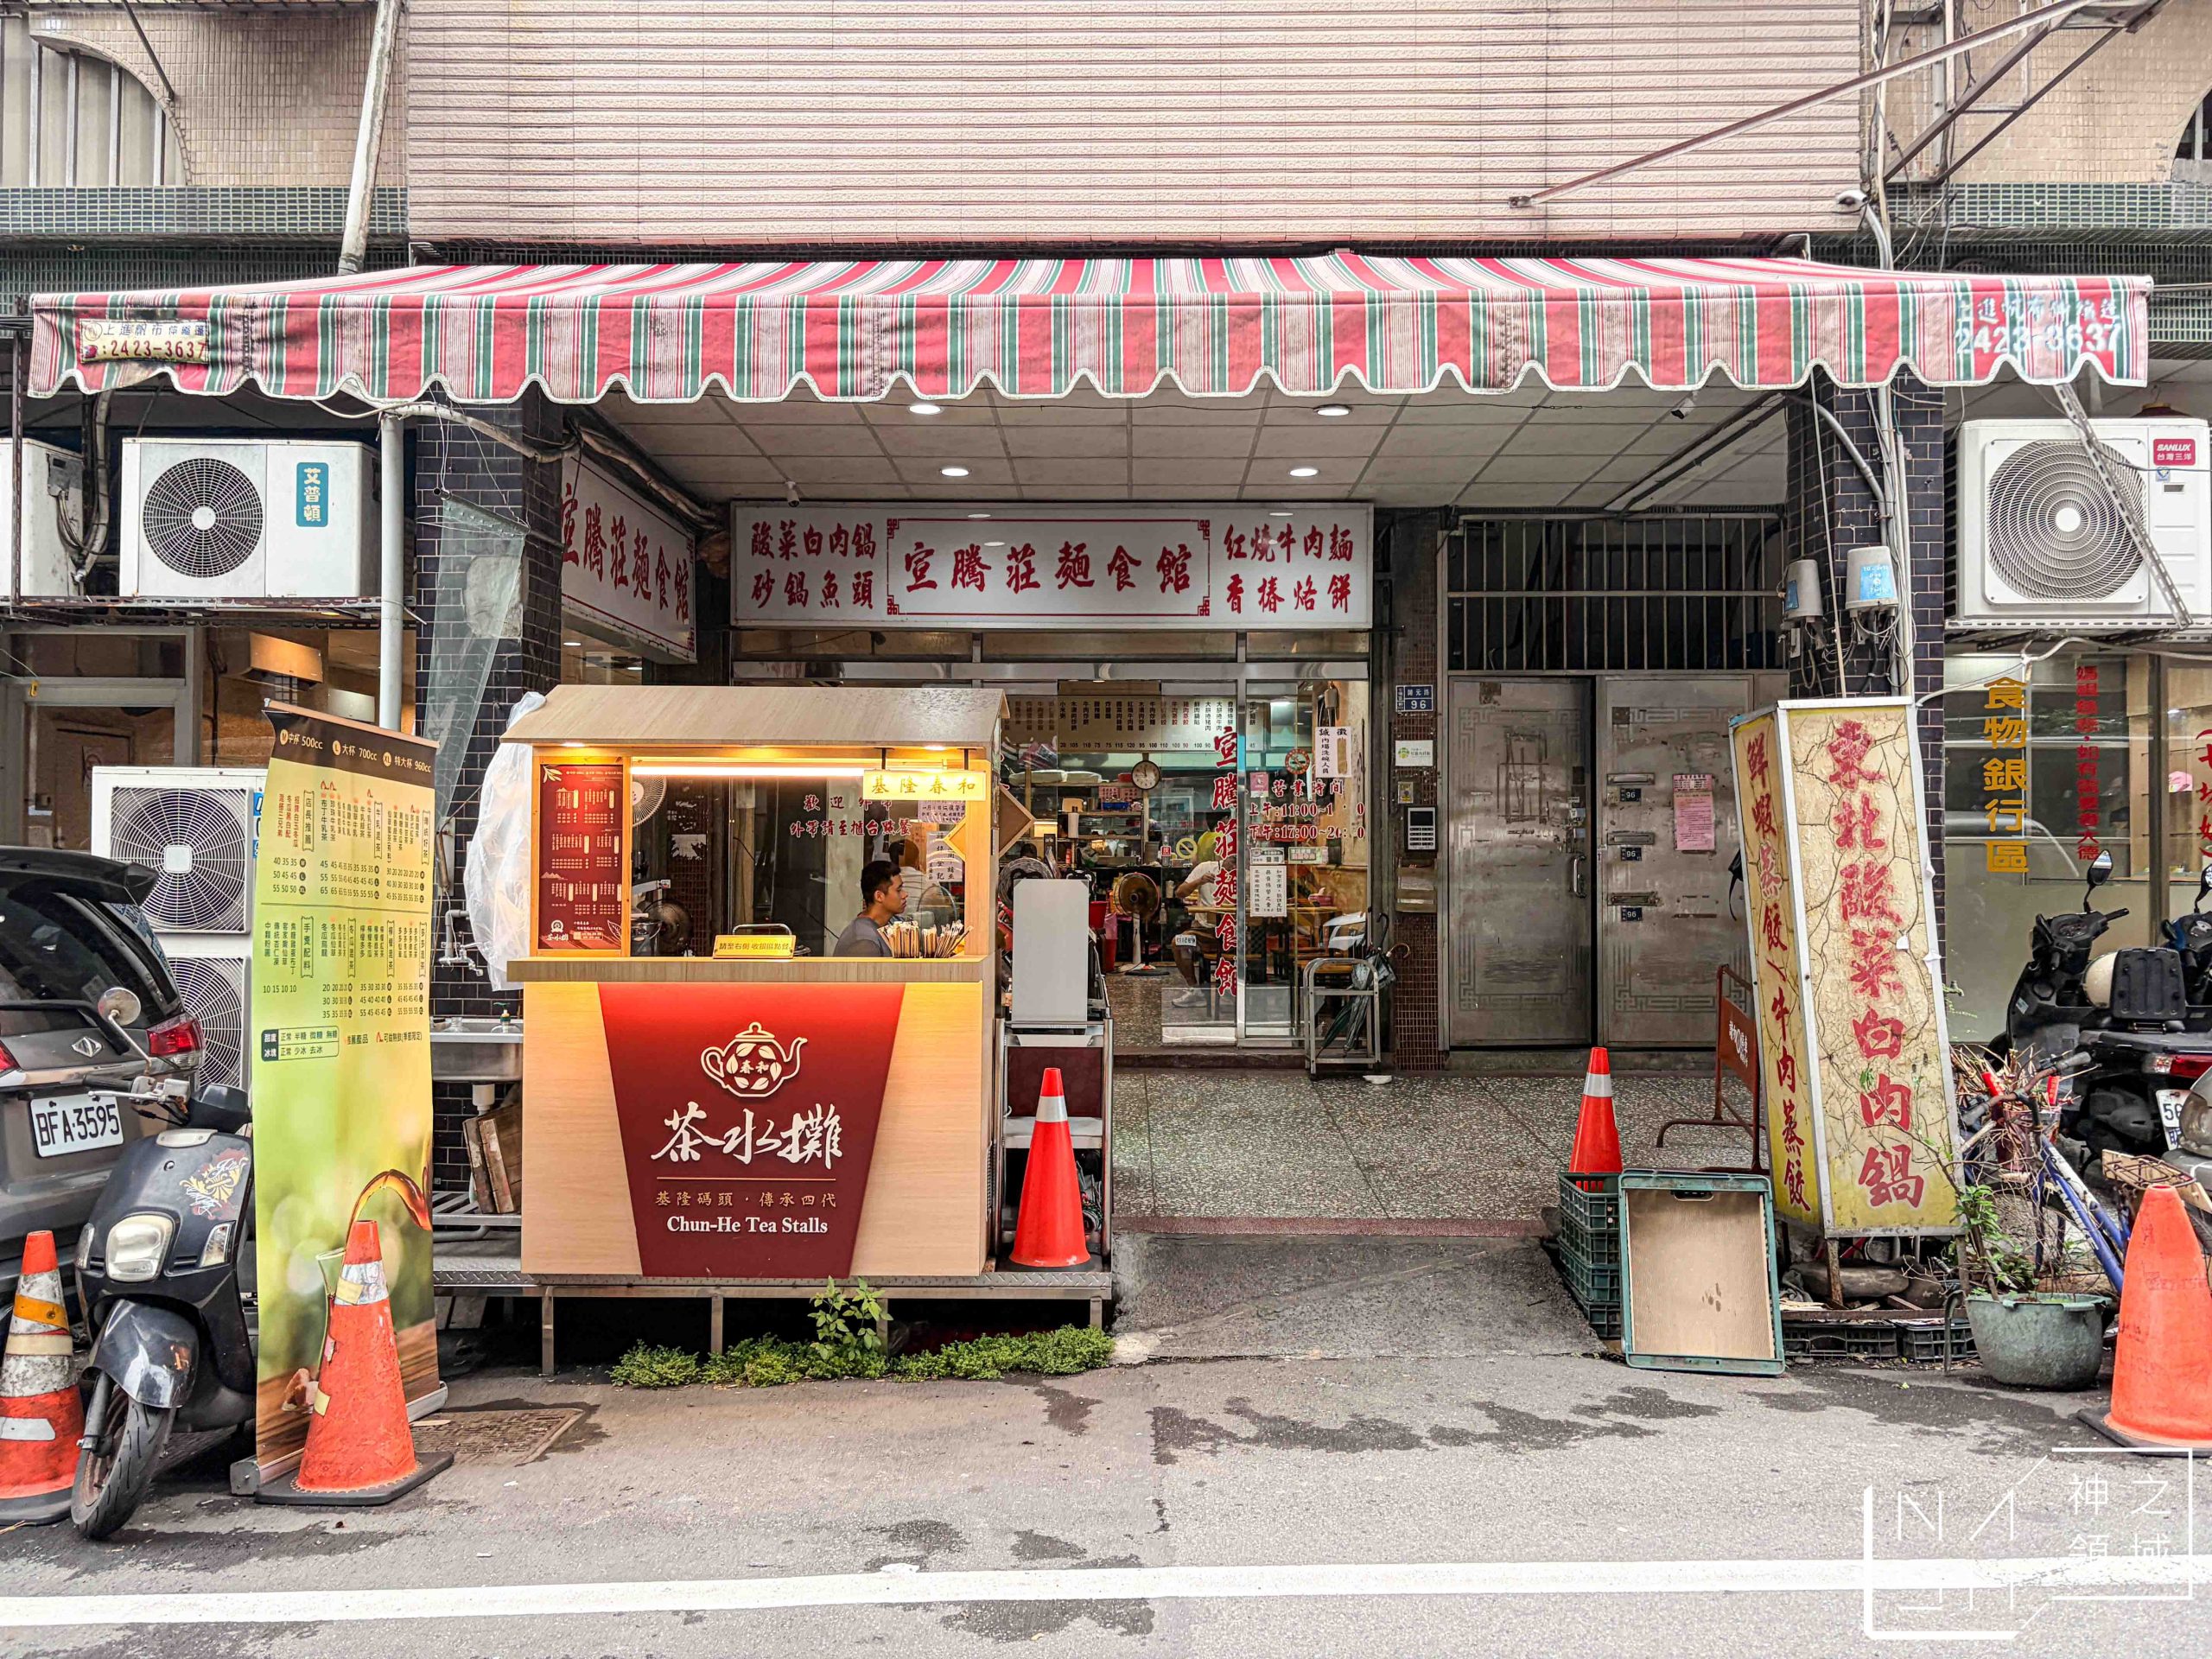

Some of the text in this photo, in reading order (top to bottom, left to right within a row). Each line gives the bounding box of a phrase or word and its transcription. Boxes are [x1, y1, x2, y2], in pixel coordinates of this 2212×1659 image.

[2157, 443, 2191, 452] SANLUX
[302, 467, 321, 523] 艾普頓
[752, 519, 877, 562] 酸菜白肉鍋
[1224, 523, 1354, 563] 紅燒牛肉麵
[905, 541, 1193, 594] 宣騰莊麵食館
[752, 569, 874, 609] 砂鍋魚頭
[1226, 573, 1351, 614] 香椿烙餅
[1411, 700, 1427, 709] 96
[289, 733, 300, 745] 中杯
[302, 735, 323, 750] 500cc
[342, 744, 355, 756] 大杯
[359, 747, 378, 761] 700cc
[395, 755, 412, 768] 特大杯
[415, 760, 431, 773] 960cc
[871, 775, 976, 794] 基隆春和
[1983, 677, 2029, 873] 食物銀行區
[790, 817, 912, 837] 外帶請至櫃台點餐
[273, 857, 281, 866] 40
[282, 858, 289, 867] 35
[321, 860, 328, 868] 45
[264, 985, 271, 994] 10
[295, 1046, 306, 1055] 少冰
[310, 1046, 322, 1054] 去冰
[740, 1059, 771, 1074] 春和
[651, 1101, 843, 1170] 茶水攤
[667, 1216, 829, 1234] Chun-He Tea Stalls
